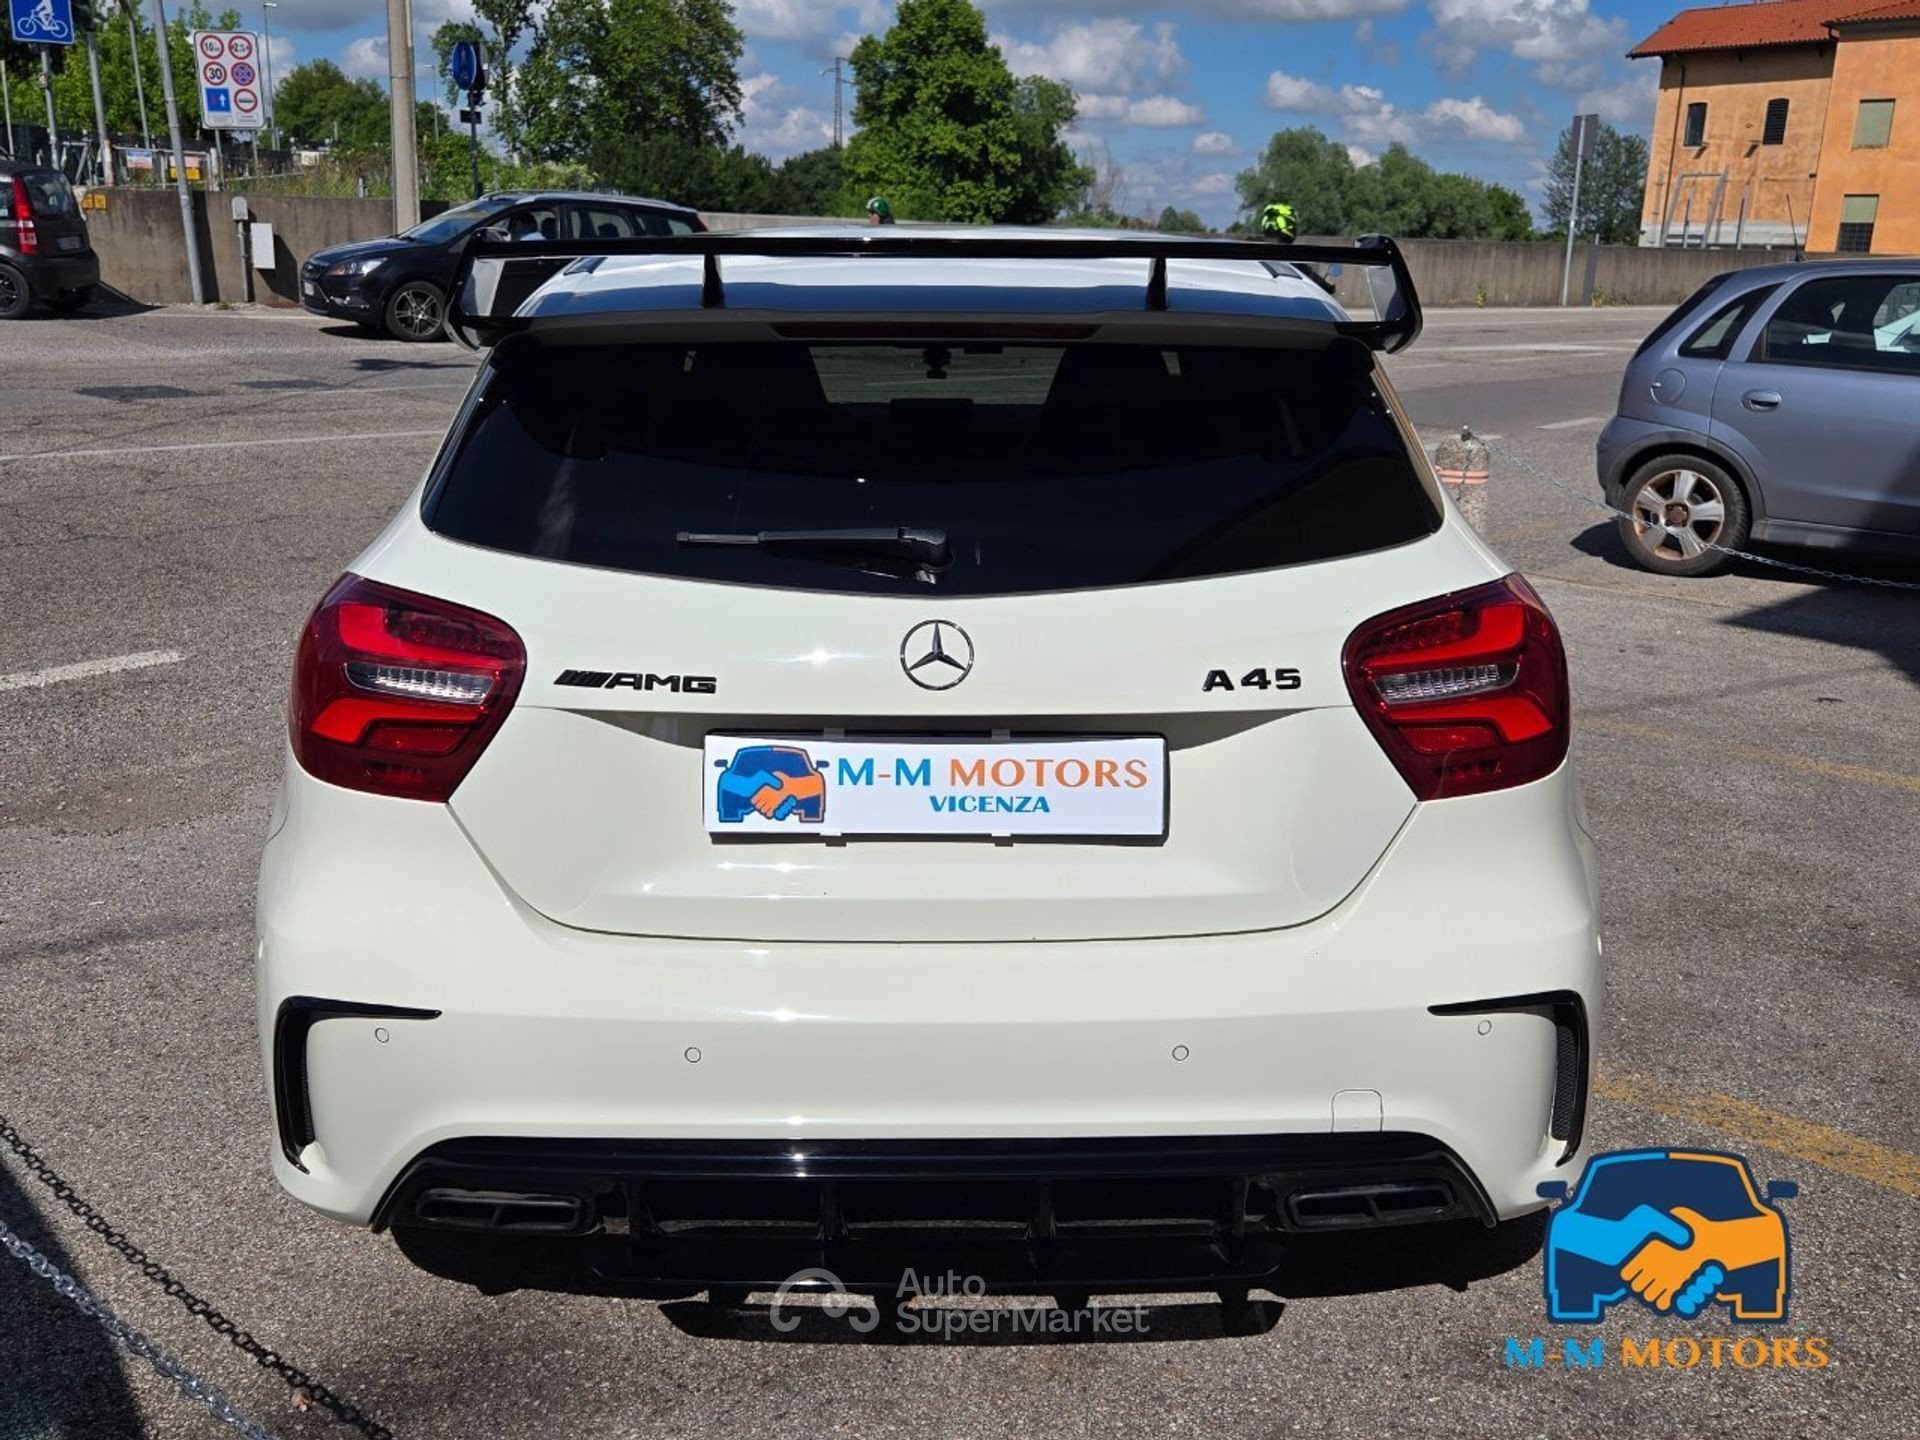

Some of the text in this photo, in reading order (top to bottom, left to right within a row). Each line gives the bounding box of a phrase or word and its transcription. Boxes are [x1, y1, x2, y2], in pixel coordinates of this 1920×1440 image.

[209, 67, 222, 80] 30
[604, 672, 717, 694] AMG
[837, 757, 1148, 789] M-M MOTORS
[929, 795, 1051, 813] VICENZA
